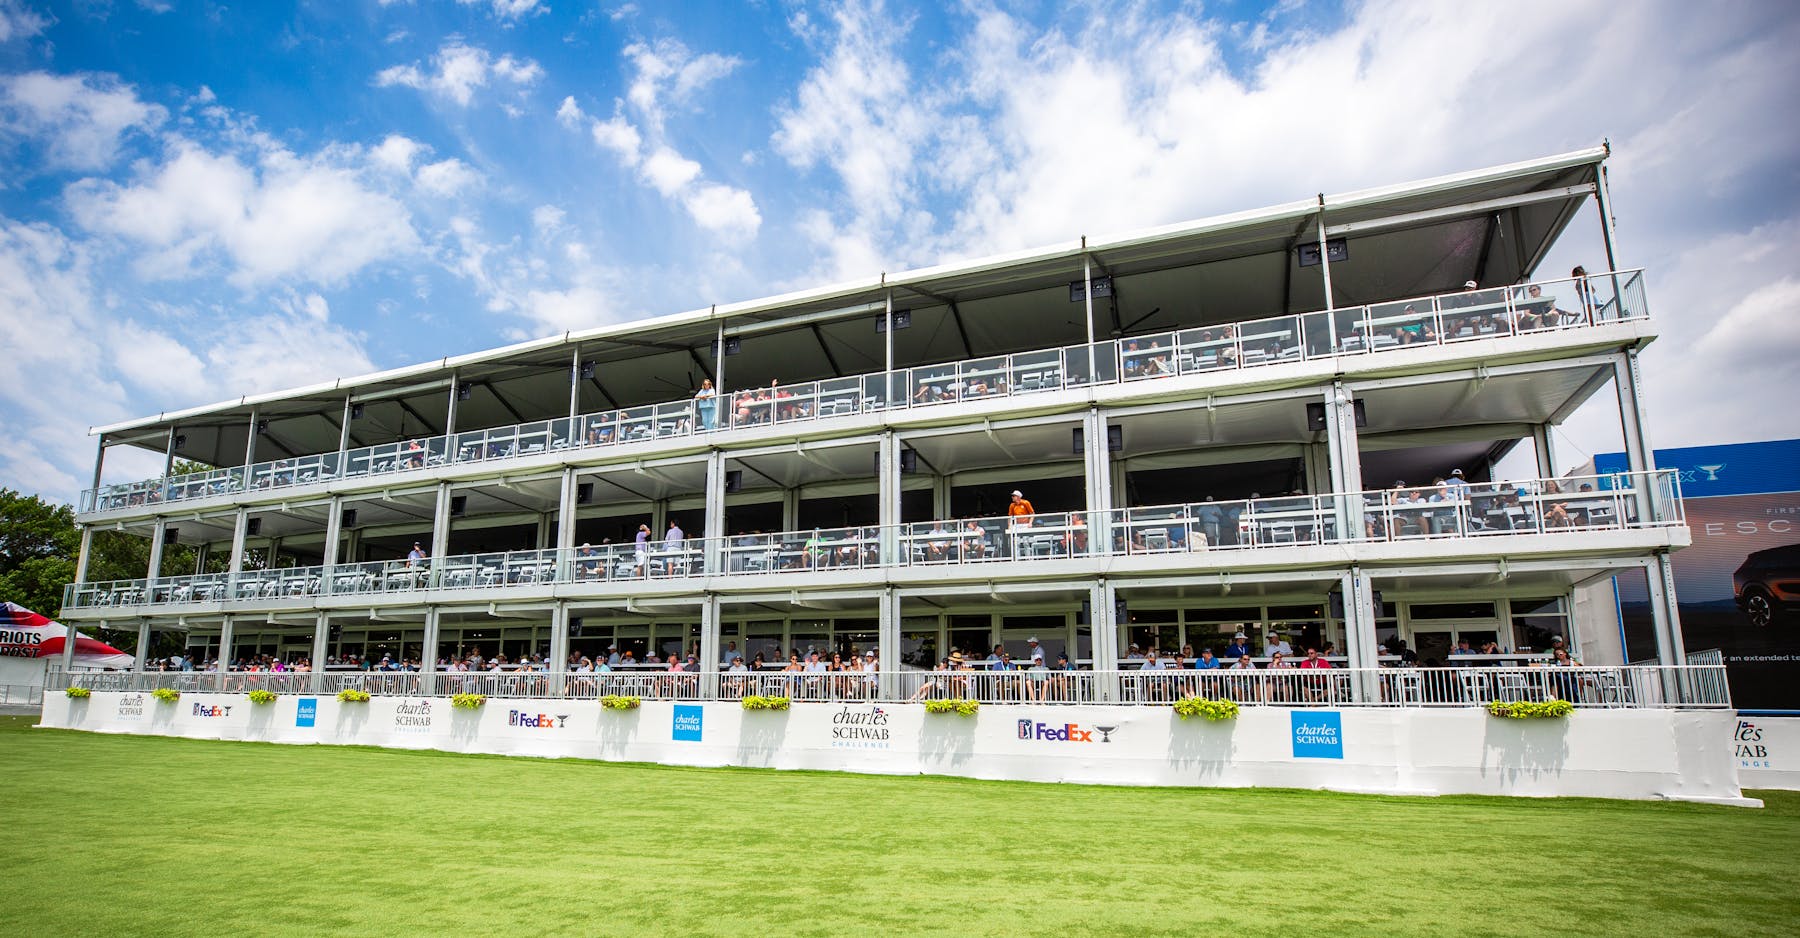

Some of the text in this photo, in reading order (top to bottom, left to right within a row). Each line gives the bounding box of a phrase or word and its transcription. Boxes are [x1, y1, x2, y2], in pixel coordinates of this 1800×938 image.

[0, 630, 42, 645] RIOTS
[1743, 654, 1790, 662] extended
[199, 705, 223, 717] FedEx
[396, 700, 432, 715] charles
[395, 715, 432, 727] SCHWAB
[520, 713, 555, 728] FedEx
[675, 713, 700, 725] charles
[833, 706, 889, 726] charles
[832, 727, 889, 740] SCHWAB
[1036, 722, 1093, 742] FedEx
[1296, 722, 1337, 736] charles
[1296, 735, 1338, 745] SCHWAB
